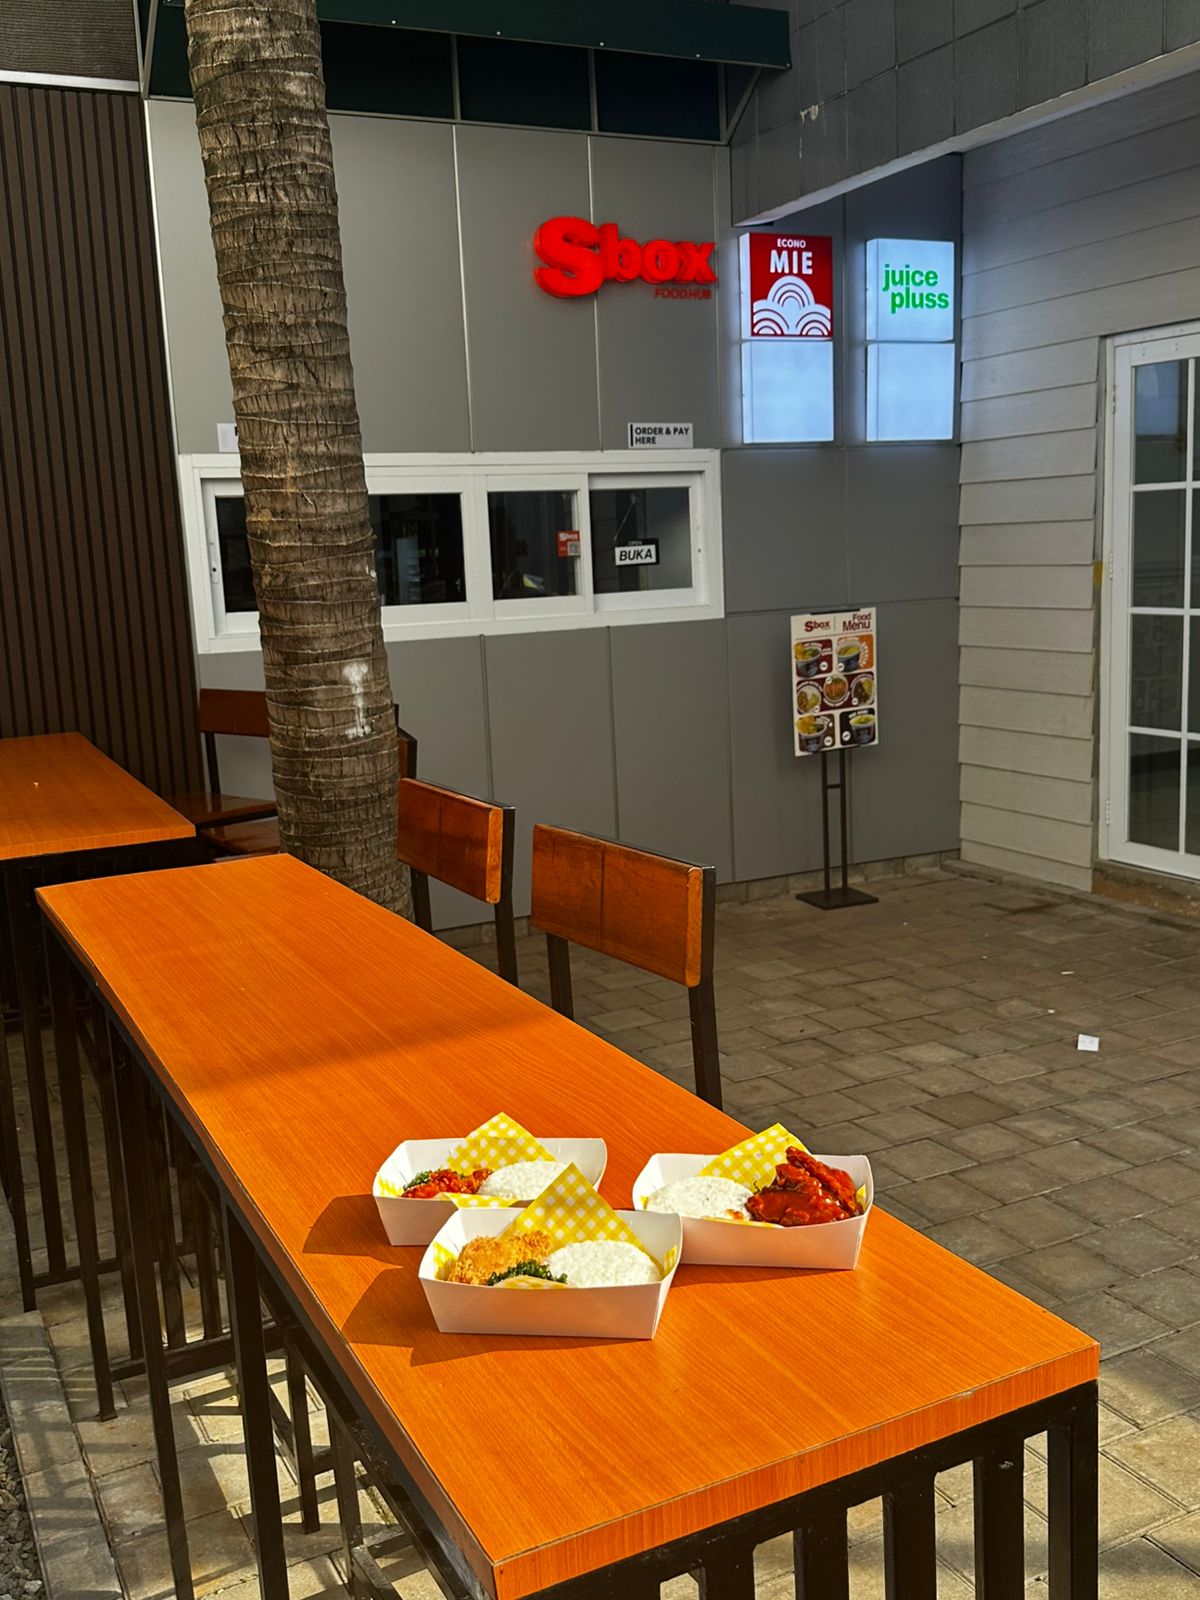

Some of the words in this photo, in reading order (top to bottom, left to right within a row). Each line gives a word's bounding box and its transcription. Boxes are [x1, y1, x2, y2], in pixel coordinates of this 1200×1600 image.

[777, 238, 806, 249] ECONO
[534, 216, 718, 299] Sbox
[770, 249, 813, 275] MIE
[882, 264, 938, 292] juice
[655, 288, 687, 299] FOOD
[689, 288, 712, 300] HUB
[891, 287, 949, 313] pluss
[635, 427, 663, 435] ORDER
[665, 427, 671, 435] &
[673, 427, 690, 435] PAY
[635, 436, 656, 445] HERE
[619, 548, 652, 561] BUKA
[852, 612, 871, 621] Food
[804, 620, 830, 632] Sbox
[842, 620, 870, 632] Menu
